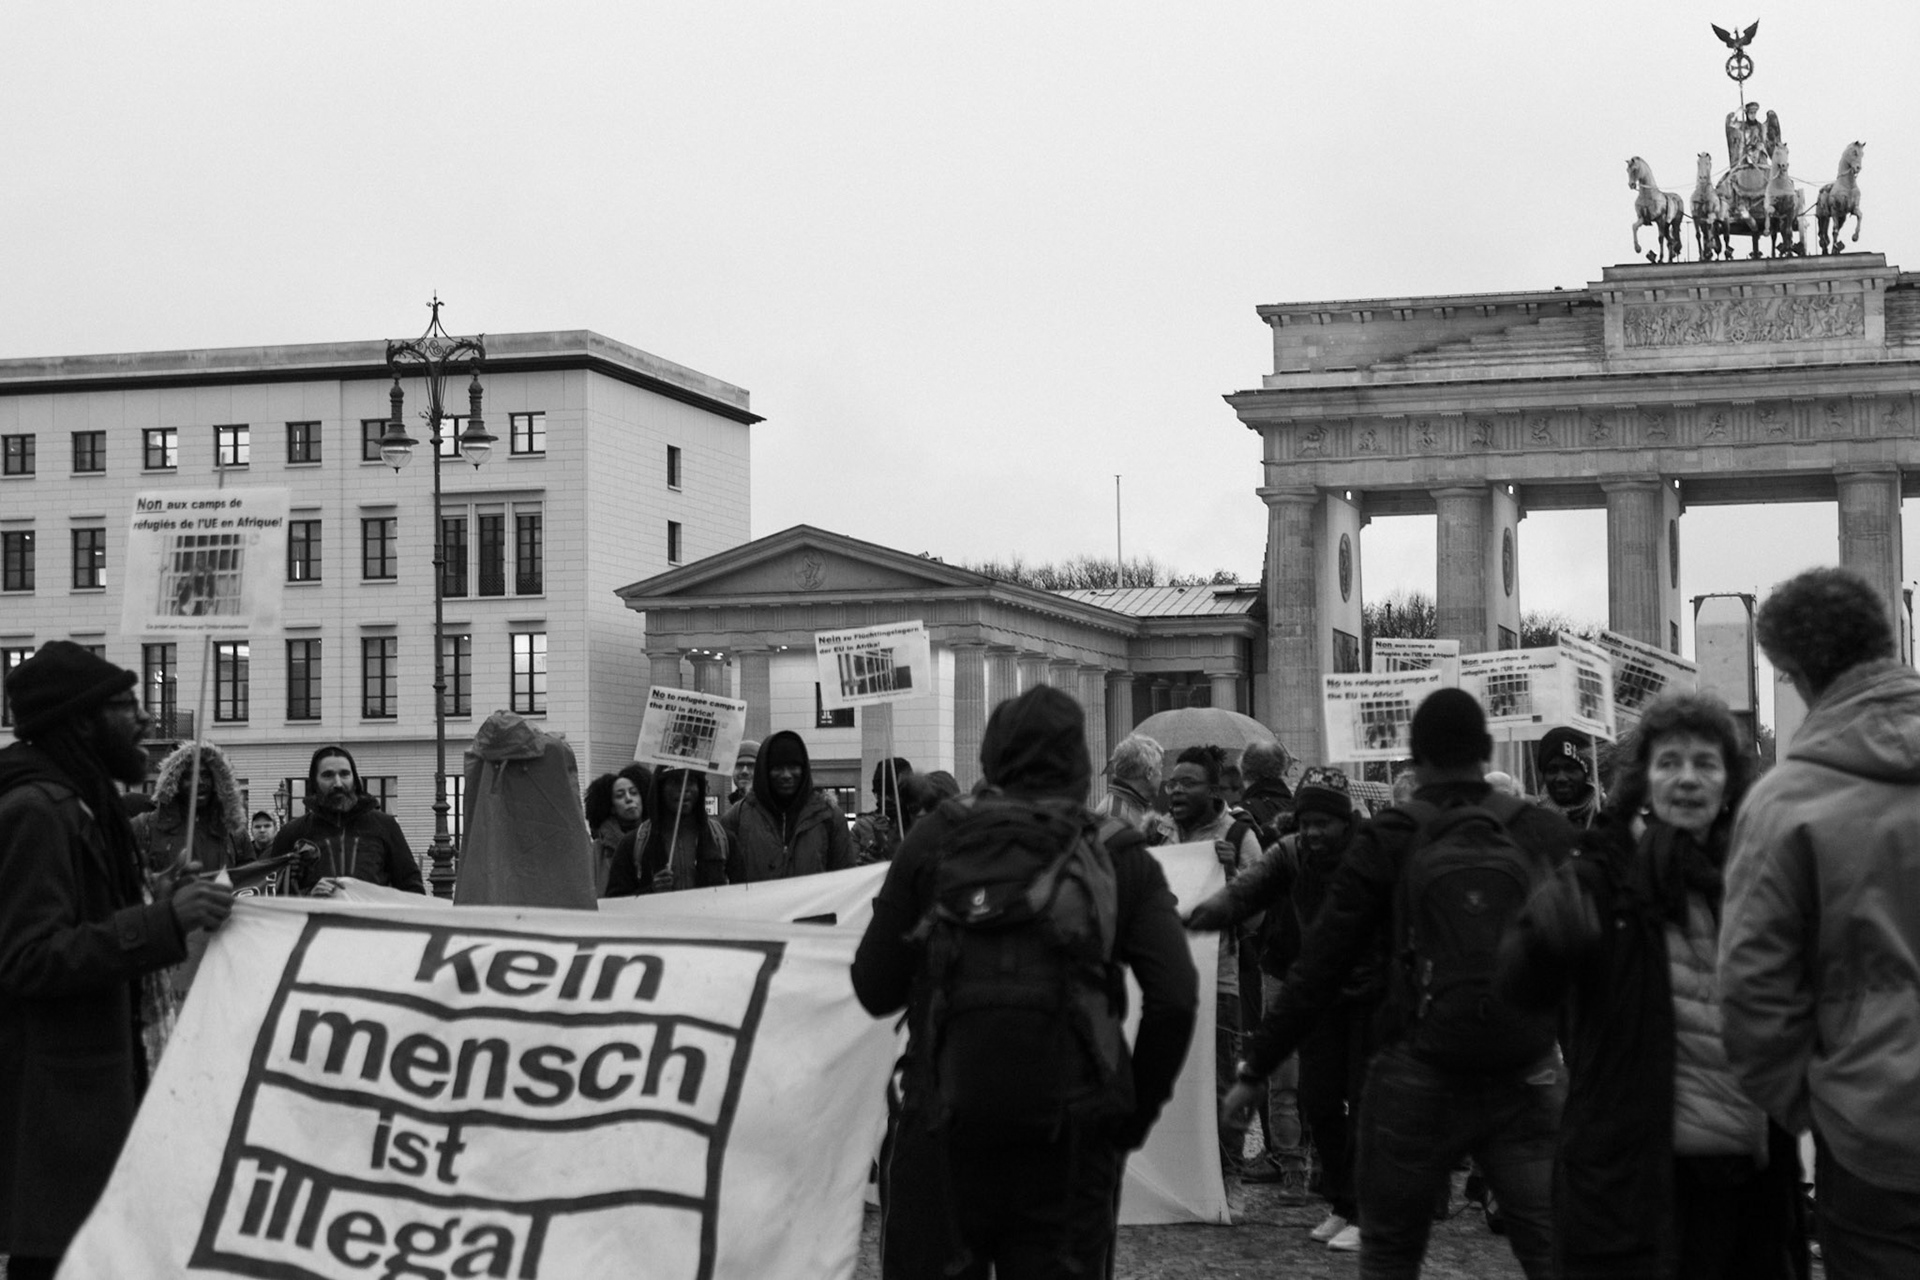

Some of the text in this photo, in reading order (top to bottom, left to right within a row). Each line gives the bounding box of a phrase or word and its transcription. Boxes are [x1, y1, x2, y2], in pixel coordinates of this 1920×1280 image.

[137, 498, 242, 511] Non aux camps de
[180, 518, 194, 530] de
[221, 519, 234, 528] en
[237, 516, 283, 530] Afrique!
[818, 634, 841, 645] Nein
[856, 641, 880, 650] Afrika!
[652, 689, 665, 699] No
[677, 695, 707, 705] refugee
[709, 700, 736, 711] camps
[649, 702, 663, 710] the
[665, 704, 677, 712] EU
[687, 708, 715, 718] Africa!
[414, 930, 665, 1002] kein
[290, 1008, 708, 1107] mensch
[371, 1109, 466, 1185] ist
